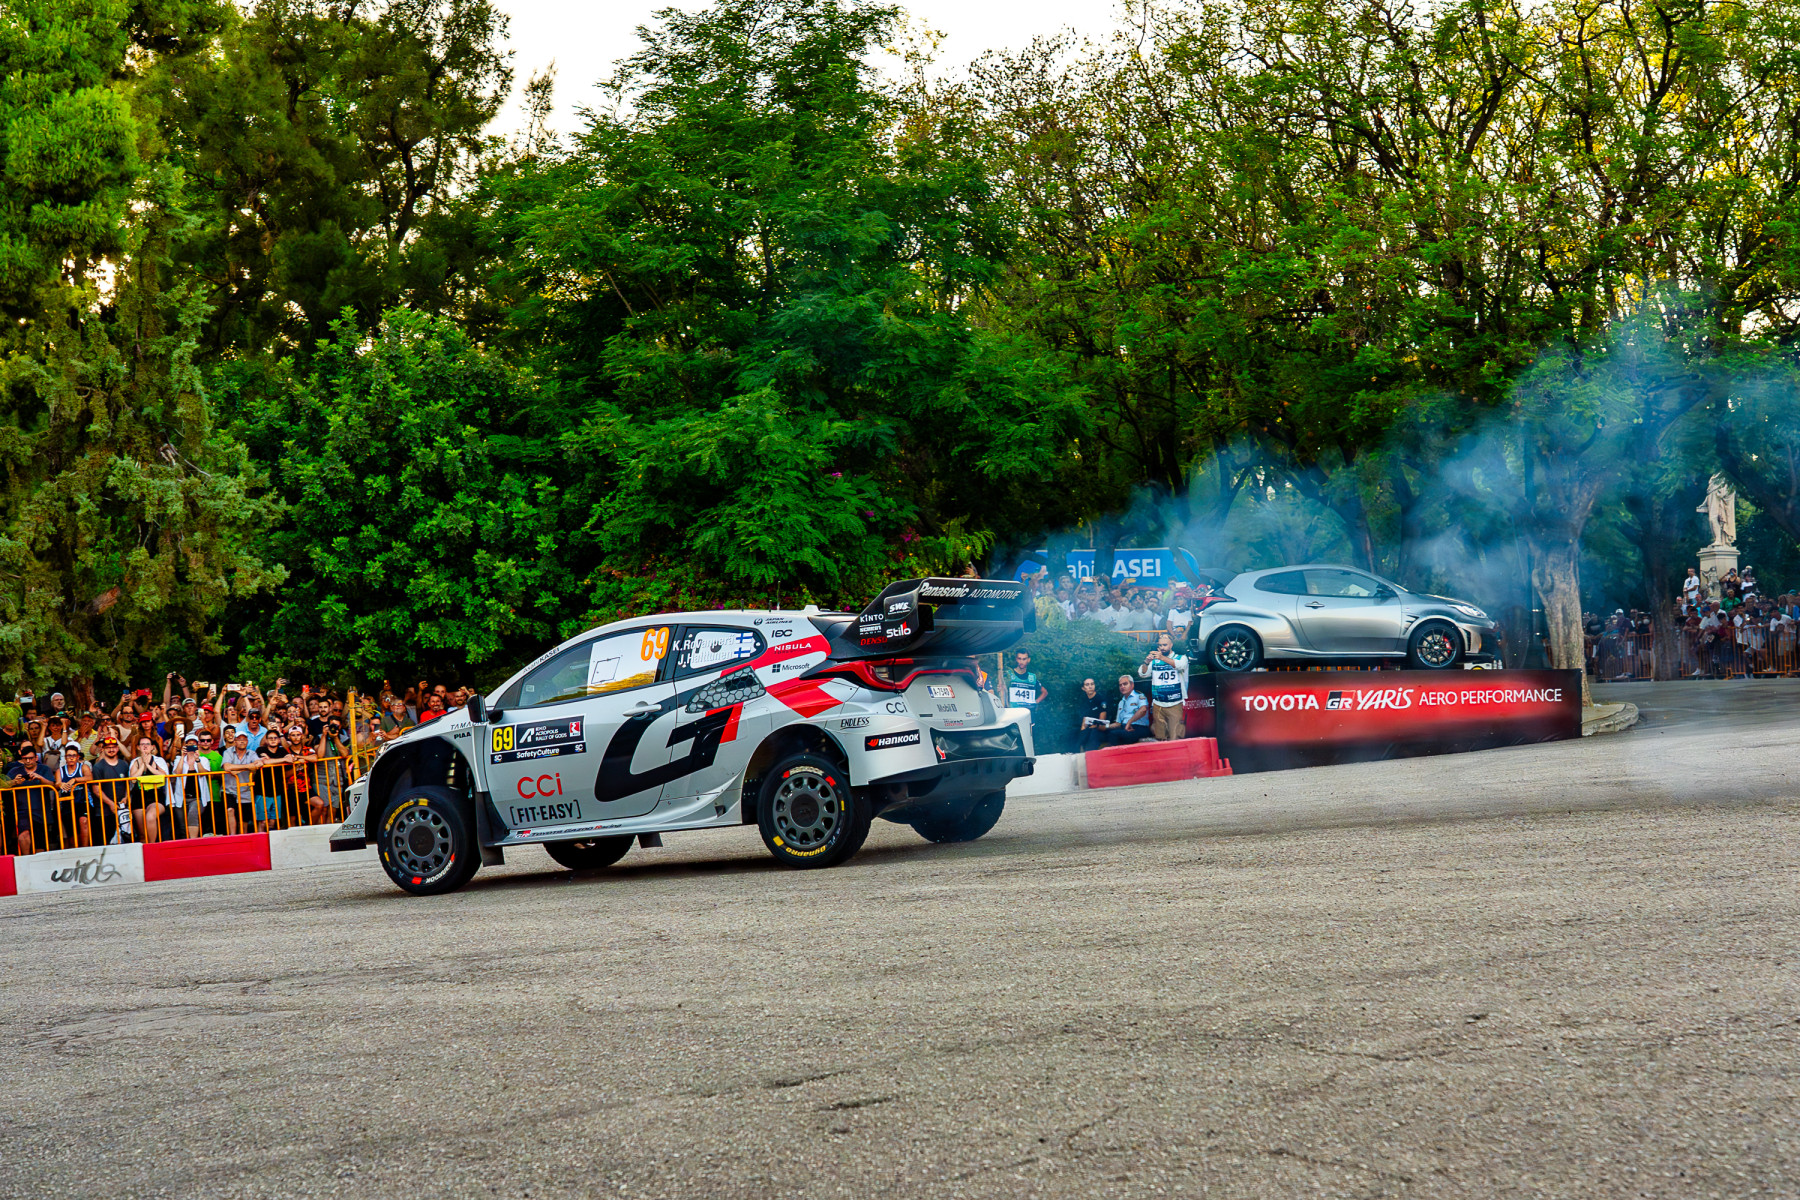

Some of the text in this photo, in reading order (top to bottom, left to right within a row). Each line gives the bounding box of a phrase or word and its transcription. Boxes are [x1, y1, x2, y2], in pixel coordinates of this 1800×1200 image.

[919, 582, 1021, 599] Panasonic AUTOMOTIVE
[889, 601, 911, 612] SWS
[860, 613, 884, 623] KINTO
[886, 621, 911, 638] Stilo
[640, 626, 670, 661] 69
[774, 643, 812, 651] NISULA
[781, 662, 810, 671] Microsoft
[1157, 671, 1176, 681] 405
[1241, 694, 1320, 711] TOYOTA
[1418, 691, 1458, 706] AERO
[1460, 688, 1562, 705] PERFORMANCE
[840, 716, 870, 729] ENDLESS
[453, 731, 472, 740] PIAA
[492, 726, 514, 752] 69
[535, 734, 548, 742] RALLY
[516, 747, 560, 759] SafetyCulture
